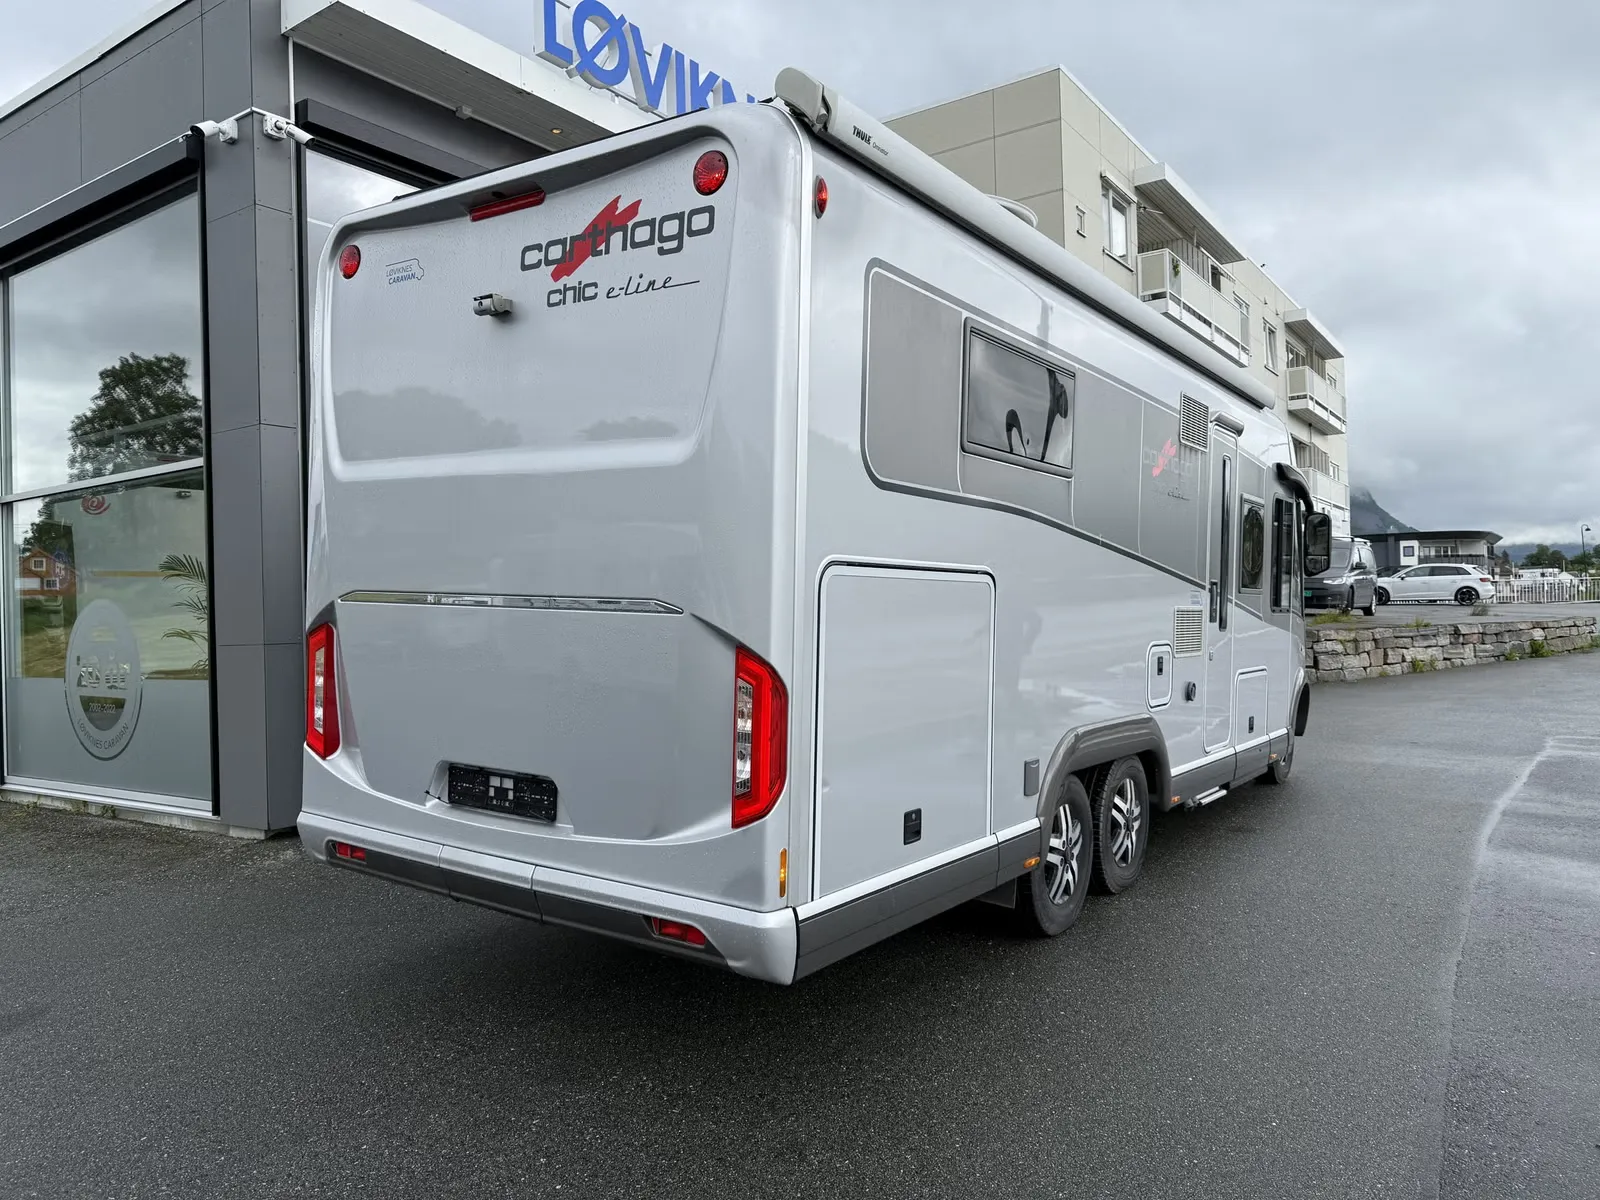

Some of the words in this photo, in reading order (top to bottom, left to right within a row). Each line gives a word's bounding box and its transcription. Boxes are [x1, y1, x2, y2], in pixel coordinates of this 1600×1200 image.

[852, 125, 872, 145] THULE
[520, 205, 716, 272] carthago
[386, 263, 413, 278] LØVIKNES
[388, 272, 416, 285] CARAVAN
[546, 280, 599, 308] chic
[606, 273, 700, 299] e-line
[89, 702, 116, 714] 2002-2022
[103, 722, 129, 750] CARAVAN
